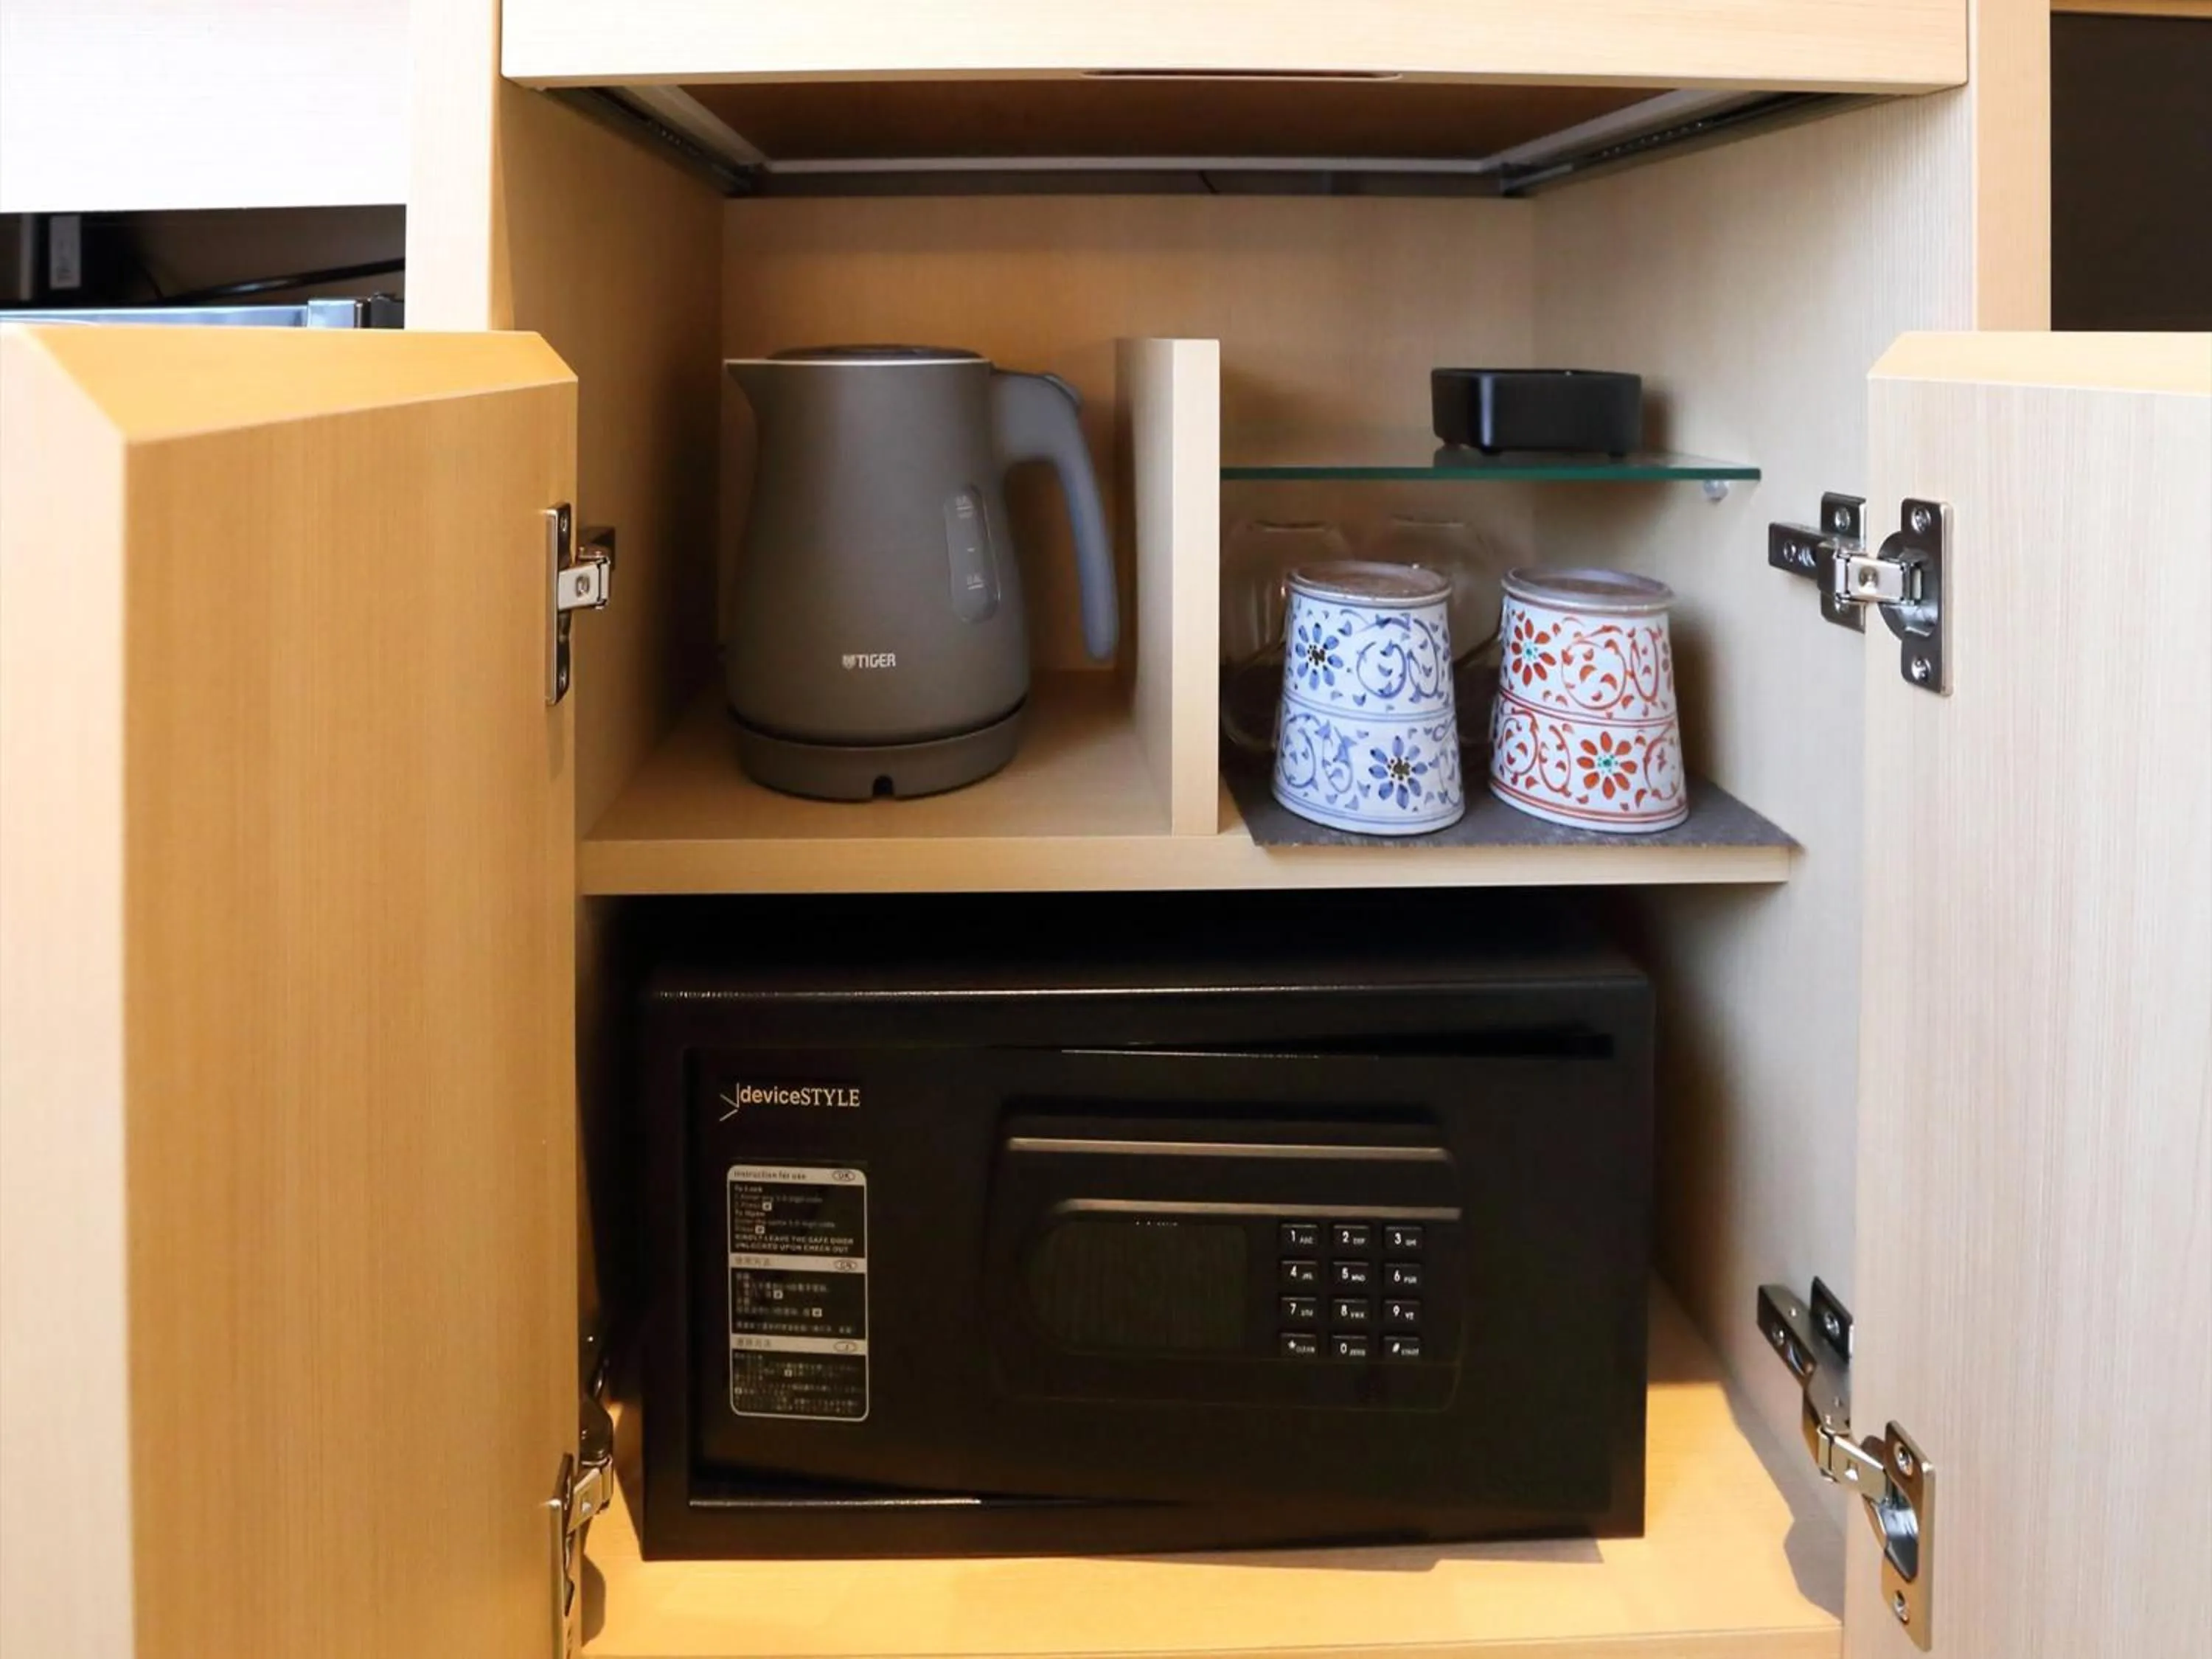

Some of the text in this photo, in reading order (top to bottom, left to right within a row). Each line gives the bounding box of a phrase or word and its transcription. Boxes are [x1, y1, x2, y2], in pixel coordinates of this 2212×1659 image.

[856, 653, 896, 668] TIGER
[740, 1085, 860, 1107] deviceSTYLE
[779, 1171, 790, 1179] for
[1291, 1230, 1295, 1242] 1
[1342, 1231, 1349, 1243] 2
[1394, 1232, 1402, 1245] 3
[1290, 1265, 1297, 1277] 4
[1342, 1267, 1349, 1279] 5
[1394, 1270, 1400, 1282] 6
[1290, 1303, 1296, 1315] 7
[1340, 1304, 1348, 1316] 8
[1393, 1305, 1400, 1317] 9
[1340, 1343, 1347, 1354] 0
